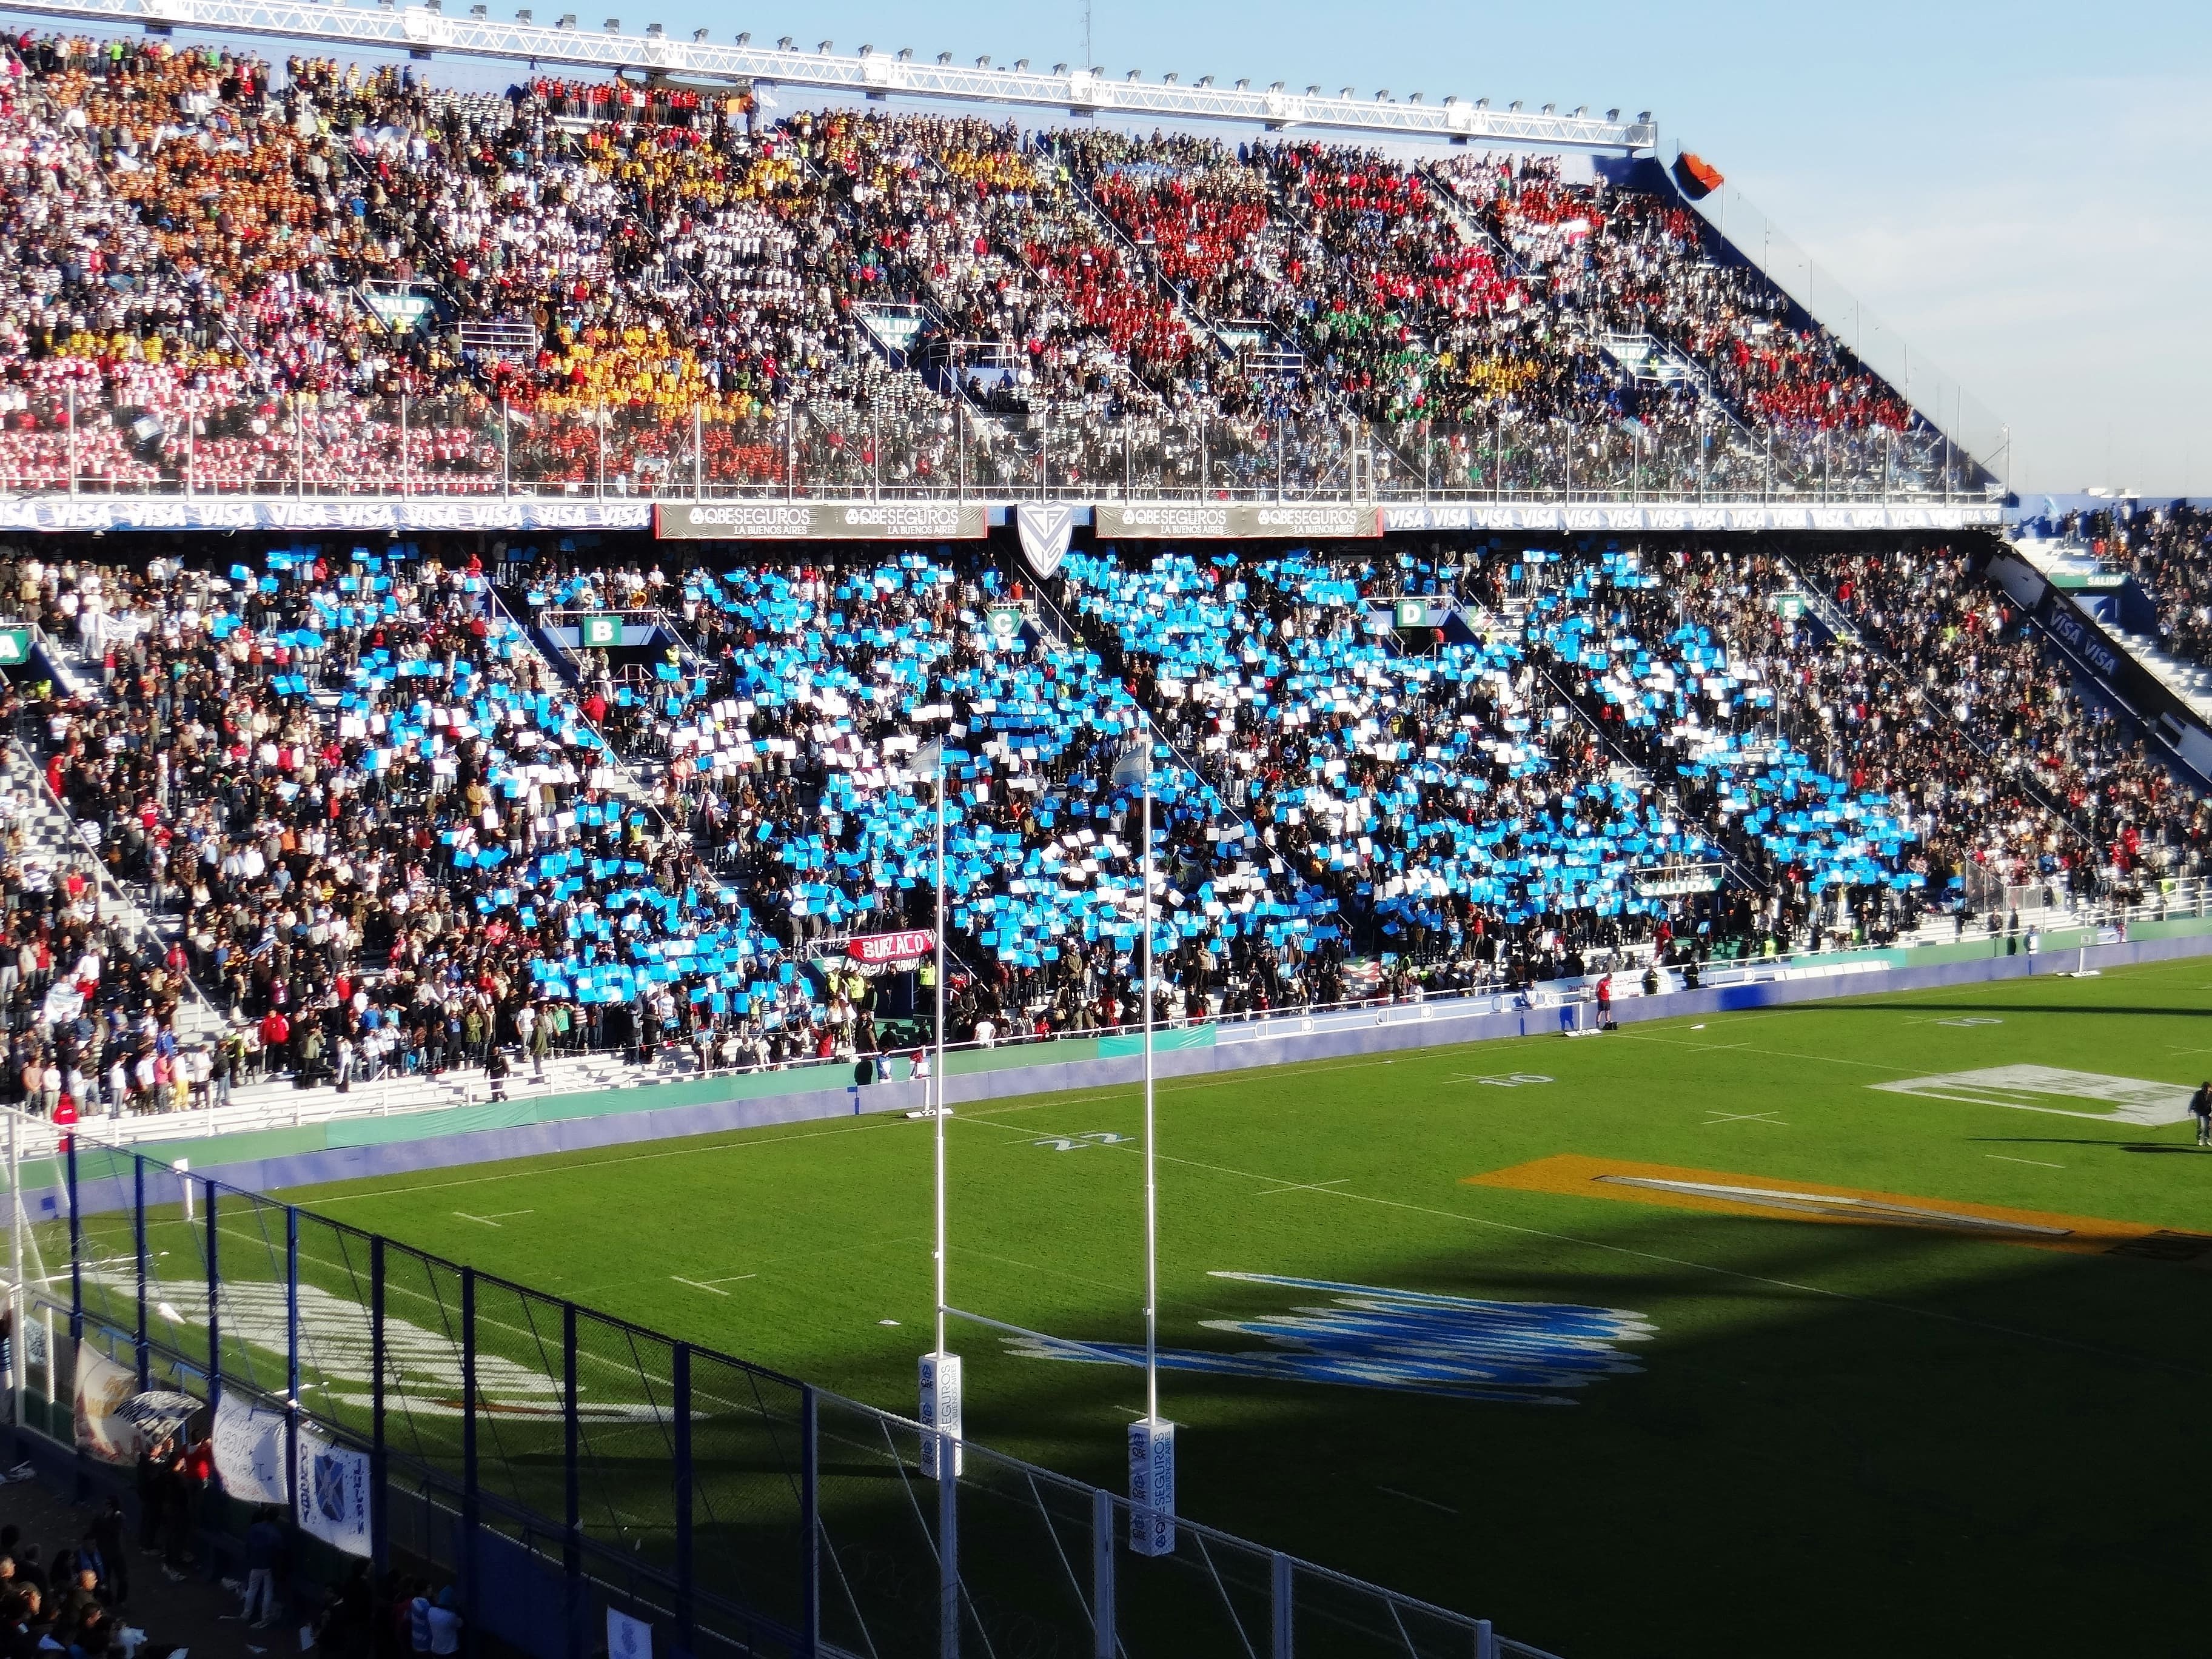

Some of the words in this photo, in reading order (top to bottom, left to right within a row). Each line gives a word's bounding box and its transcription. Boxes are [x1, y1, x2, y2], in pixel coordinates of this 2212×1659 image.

[51, 504, 110, 526] VISA
[129, 503, 186, 526] VISA
[199, 503, 257, 526] VISA
[269, 504, 325, 526] VISA
[340, 504, 393, 526] VISA
[408, 504, 459, 526] VISA
[471, 504, 523, 526] VISA
[536, 504, 586, 526] VISA
[598, 504, 650, 526] VISA
[1387, 509, 1425, 528] VISA
[1430, 510, 1470, 528] VISA
[1476, 510, 1513, 528] VISA
[1521, 510, 1558, 528] VISA
[1564, 509, 1600, 528] VISA
[1606, 509, 1641, 528] VISA
[1648, 509, 1683, 528] VISA
[1691, 510, 1726, 528] VISA
[1730, 510, 1766, 528] VISA
[734, 526, 746, 534] LA
[748, 526, 782, 535] BUENOS
[783, 526, 807, 535] AIRES
[888, 526, 898, 534] LA
[900, 526, 932, 535] BUENOS
[933, 526, 956, 534] AIRES
[1173, 526, 1201, 534] BUENOS
[1203, 526, 1224, 534] AIRES
[1305, 525, 1333, 534] BUENOS
[1335, 525, 1355, 534] AIRES
[2087, 577, 2122, 586] SALIDA
[994, 613, 1012, 632] C
[1403, 605, 1421, 623] D
[593, 622, 613, 642] B
[2050, 612, 2083, 645] VISA
[2083, 635, 2117, 675] VISA
[1640, 880, 1716, 896] SALIDA
[862, 933, 923, 959] BURZACO
[1478, 1074, 1554, 1087] 10
[1033, 1133, 1136, 1151] 22
[941, 1364, 951, 1433] SEGUROS
[1132, 1447, 1146, 1460] QBE
[1132, 1489, 1147, 1501] QBE
